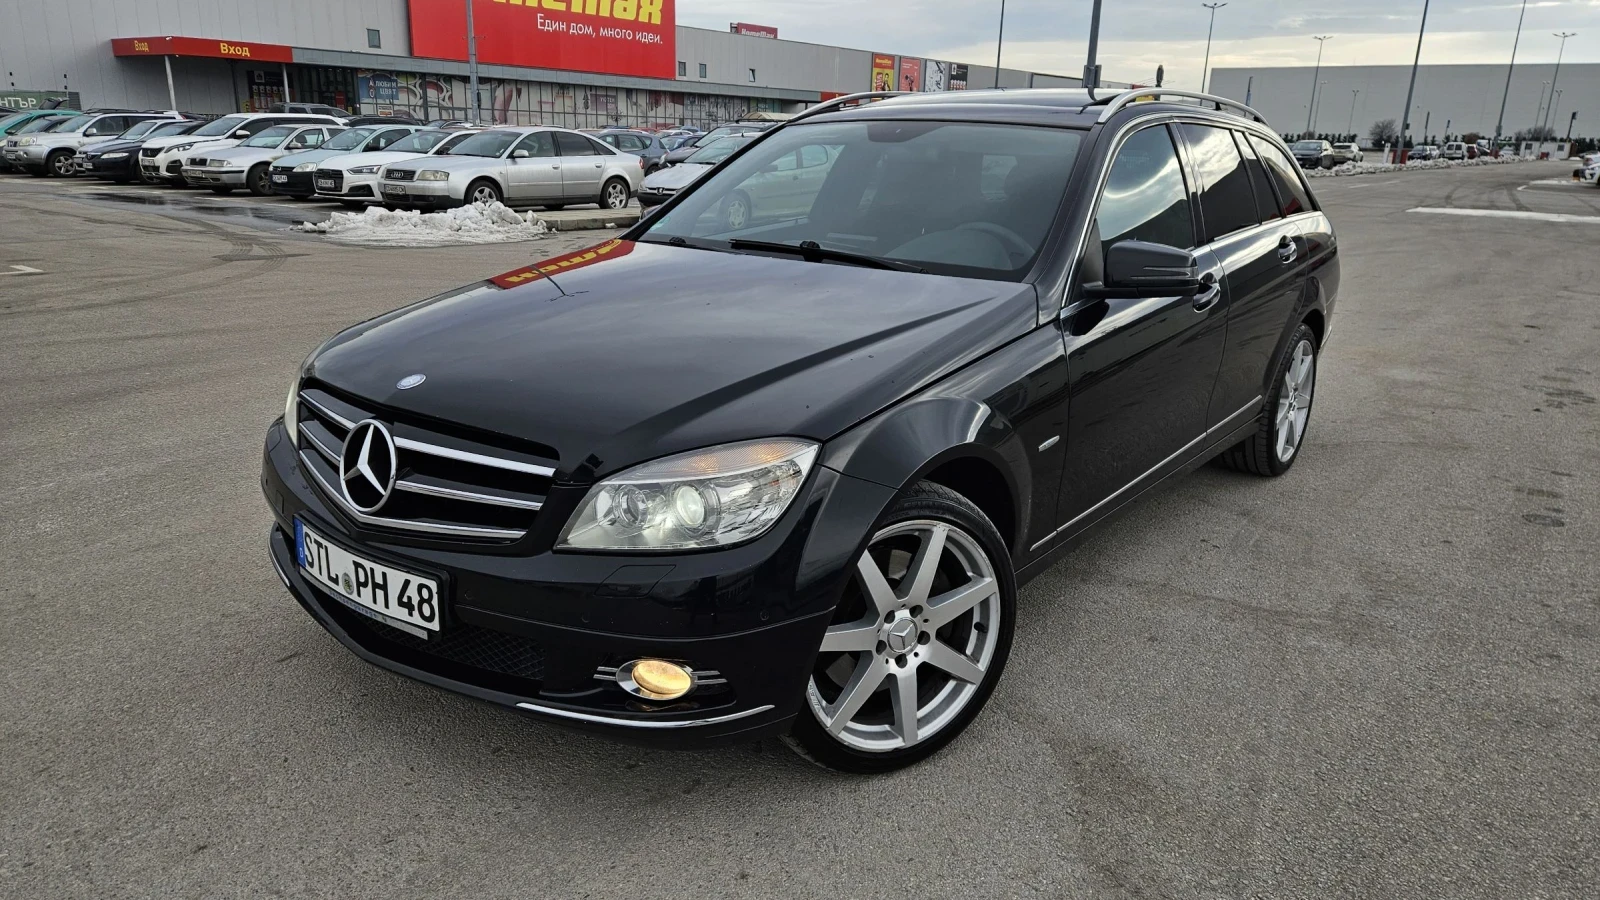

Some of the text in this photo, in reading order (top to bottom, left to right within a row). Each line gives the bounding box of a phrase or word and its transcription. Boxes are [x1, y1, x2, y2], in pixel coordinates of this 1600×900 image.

[537, 13, 663, 44] Един дом, много идеи.
[134, 40, 149, 52] Вход
[220, 42, 250, 57] Вход
[304, 532, 436, 623] STL PH 48
